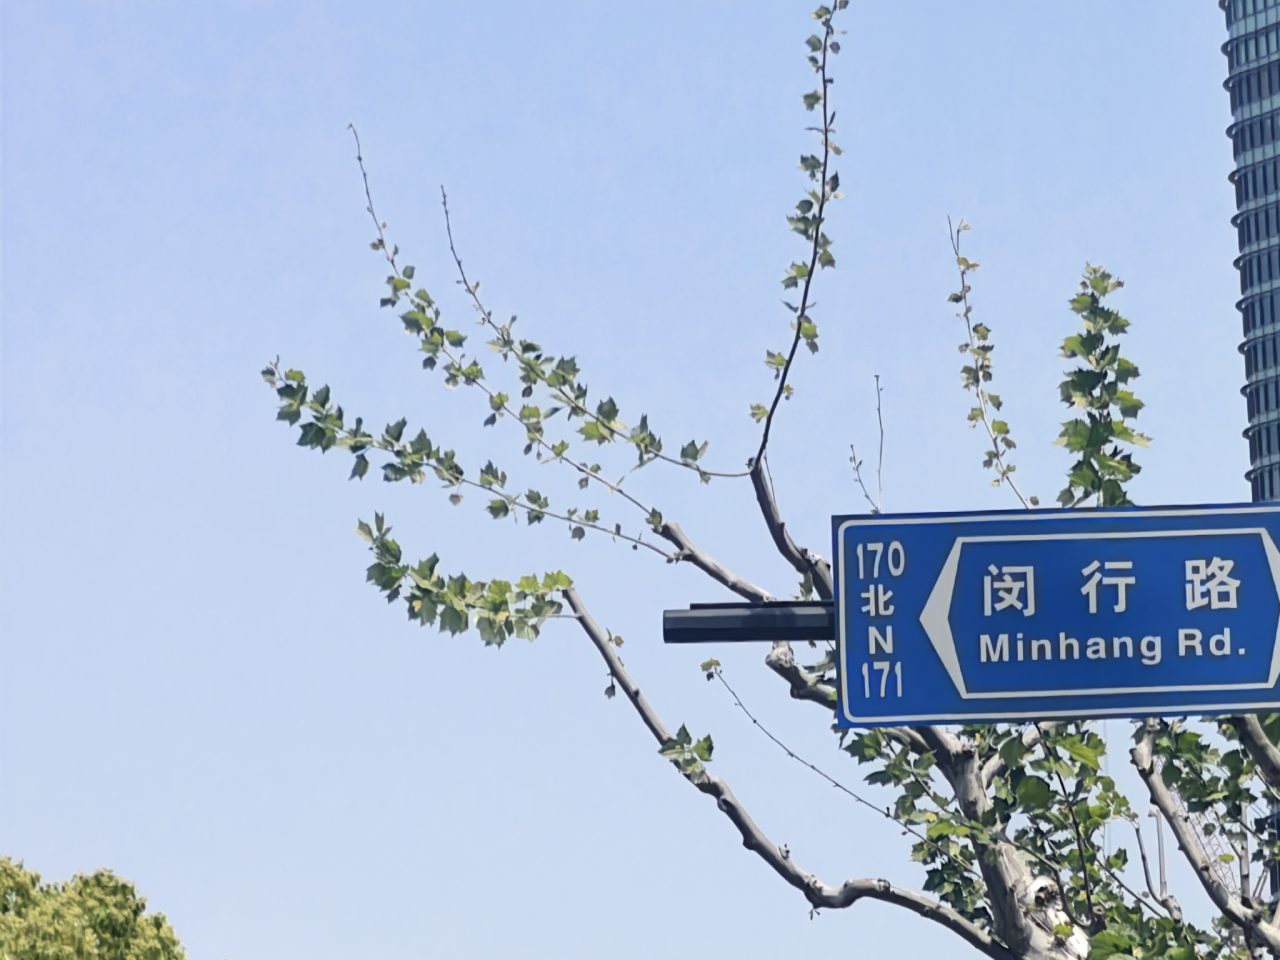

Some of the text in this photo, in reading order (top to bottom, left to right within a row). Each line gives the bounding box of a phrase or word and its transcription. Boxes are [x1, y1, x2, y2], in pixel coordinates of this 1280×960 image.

[856, 541, 905, 579] 170
[861, 584, 894, 617] 北
[983, 556, 1241, 617] 闵行路
[868, 625, 894, 655] N
[979, 627, 1246, 665] Minhang Rd.
[861, 662, 903, 699] 171
